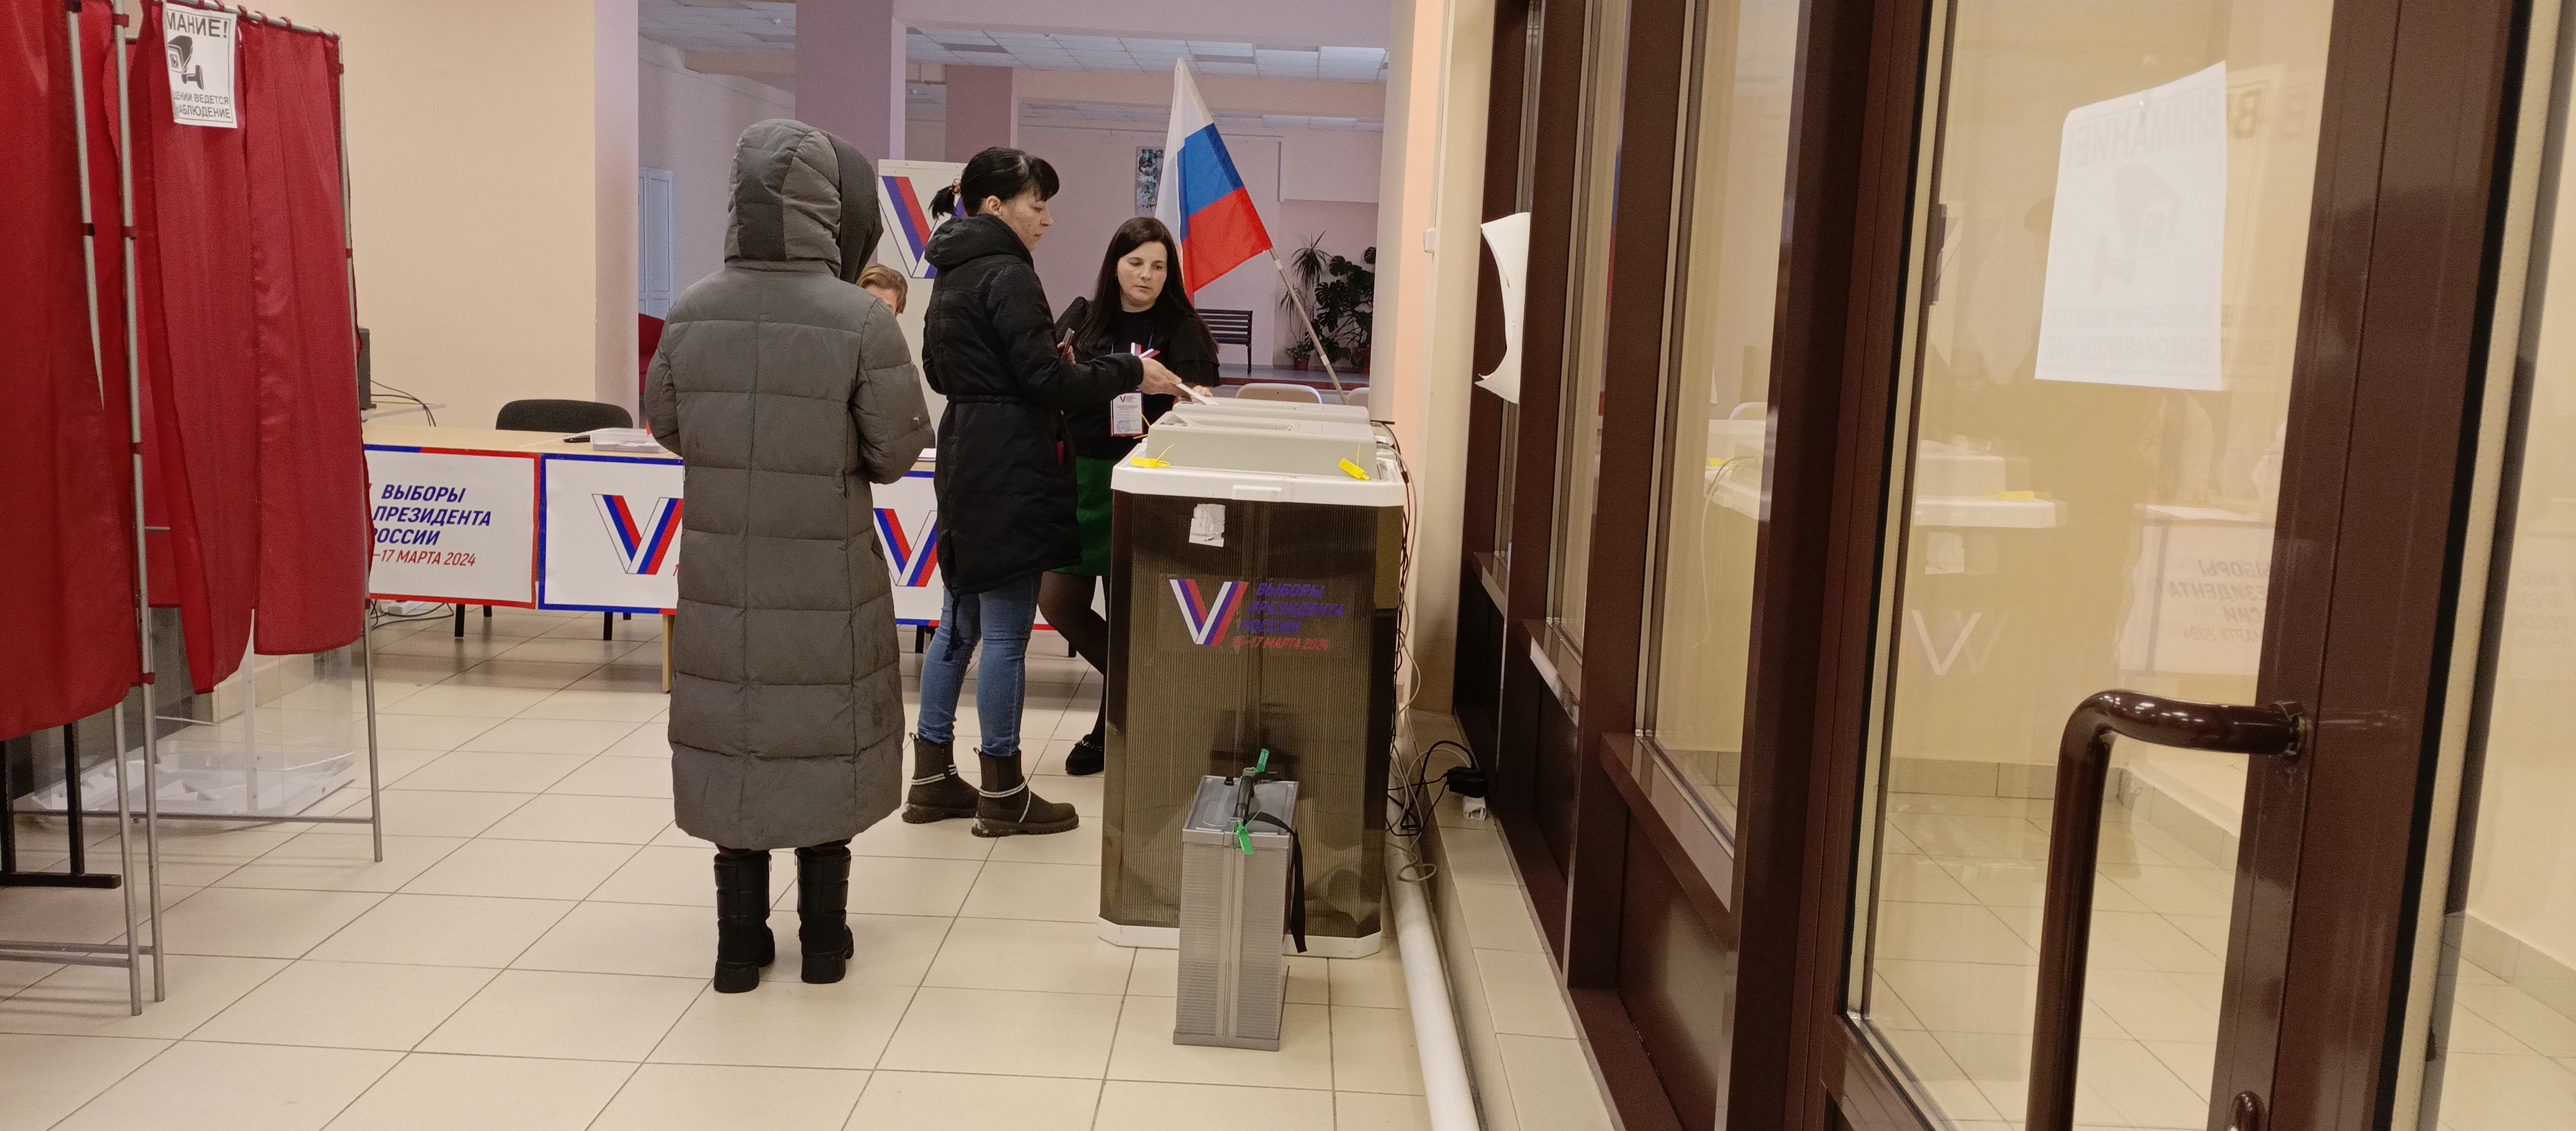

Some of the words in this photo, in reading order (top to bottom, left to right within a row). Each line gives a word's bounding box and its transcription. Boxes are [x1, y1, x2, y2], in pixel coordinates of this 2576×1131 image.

[167, 11, 227, 38] МАНИЕ!
[194, 94, 229, 105] ВЕДЕТСЯ
[381, 484, 466, 503] ВЫБОРЫ
[373, 505, 491, 526] ПРЕЗИДЕНТА
[396, 550, 441, 564] МАРТА
[443, 552, 476, 566] 2024
[1255, 582, 1325, 599] ВЫБОРЫ
[1246, 601, 1345, 618] ПРЕЗИДЕНТА
[1239, 619, 1303, 634] РОССИИ
[1263, 637, 1301, 650] МАРТА
